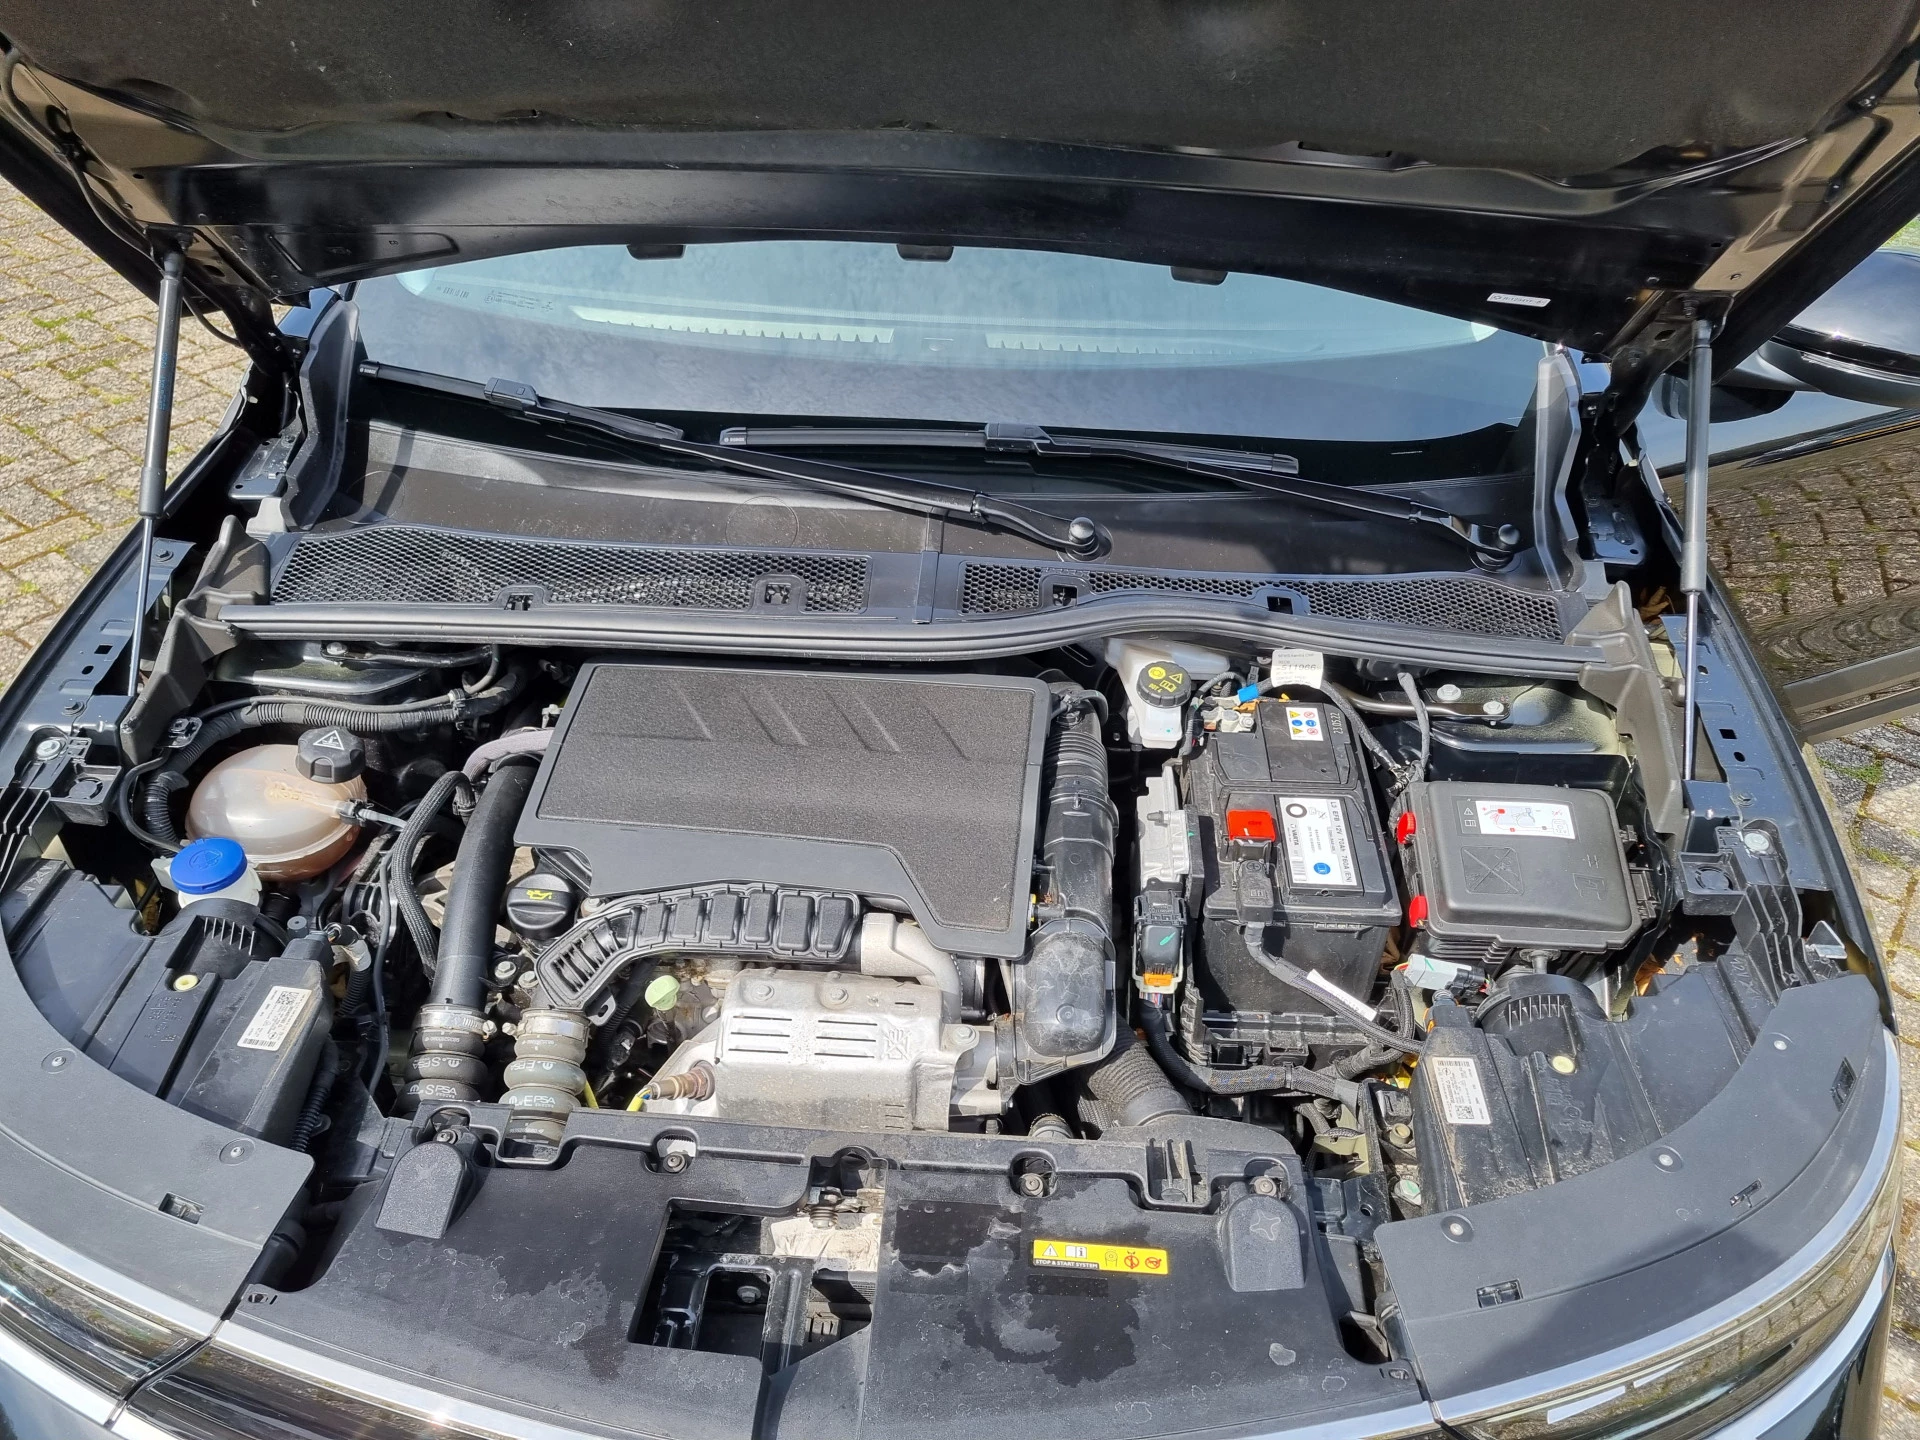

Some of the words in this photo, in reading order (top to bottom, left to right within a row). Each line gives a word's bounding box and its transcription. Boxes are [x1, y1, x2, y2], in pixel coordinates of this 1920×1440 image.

[1332, 810, 1340, 822] EFB
[1335, 825, 1343, 835] 12V
[1338, 838, 1346, 852] 70Ah
[1341, 855, 1350, 870] 760A
[435, 1084, 457, 1096] PSA
[533, 1095, 556, 1105] PSA
